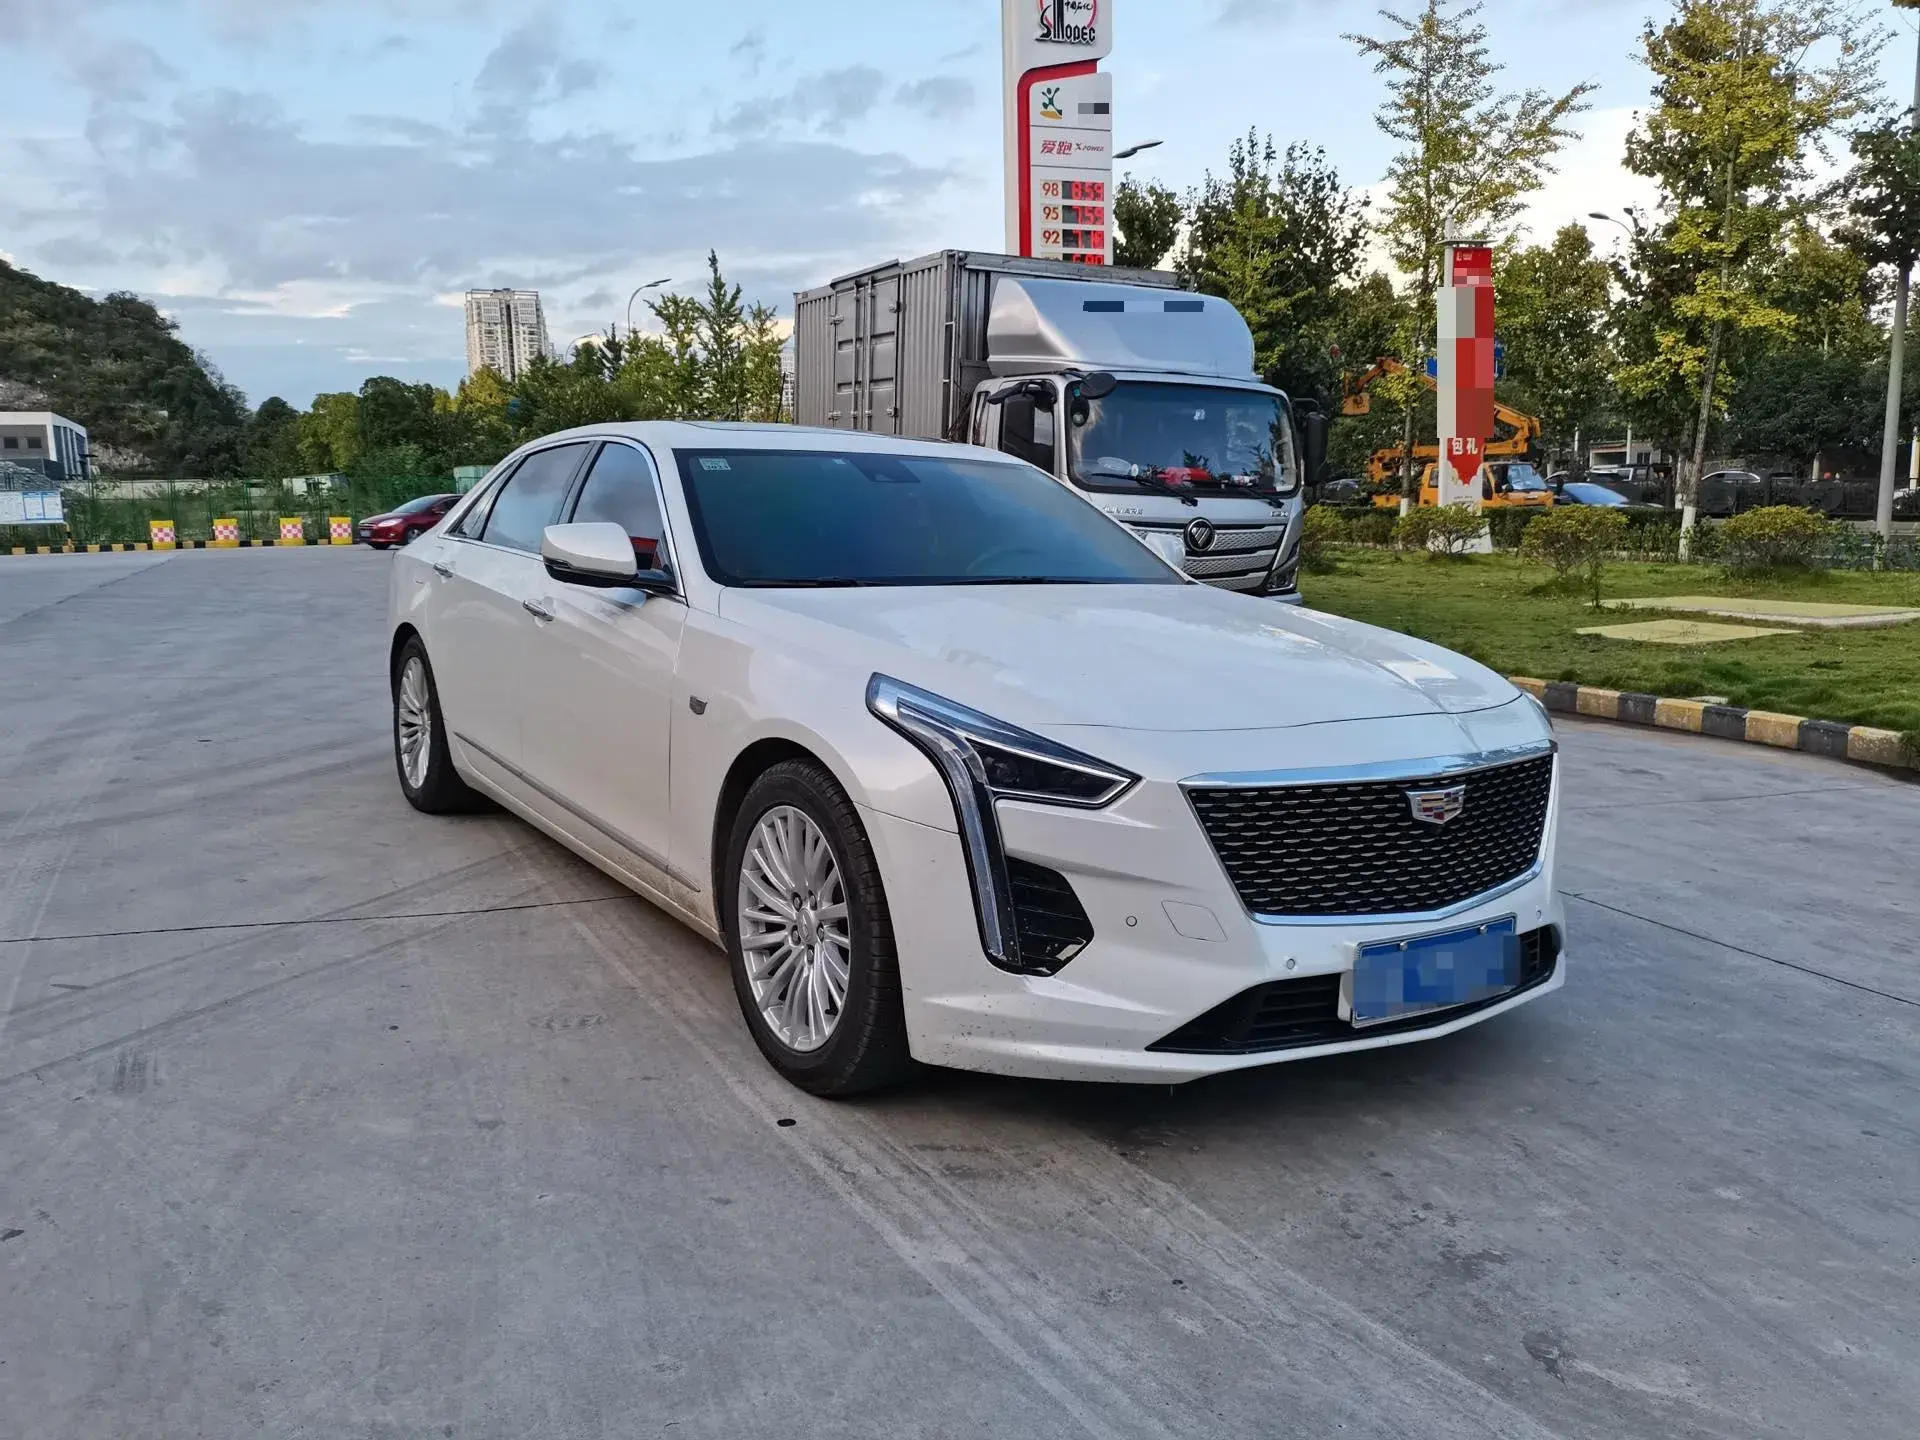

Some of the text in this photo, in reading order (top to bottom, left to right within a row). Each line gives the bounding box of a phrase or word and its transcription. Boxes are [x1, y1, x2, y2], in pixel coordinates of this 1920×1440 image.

[1041, 140, 1073, 155] 爱跑
[1043, 182, 1059, 197] 98
[1043, 206, 1059, 221] 95
[1043, 230, 1060, 244] 92
